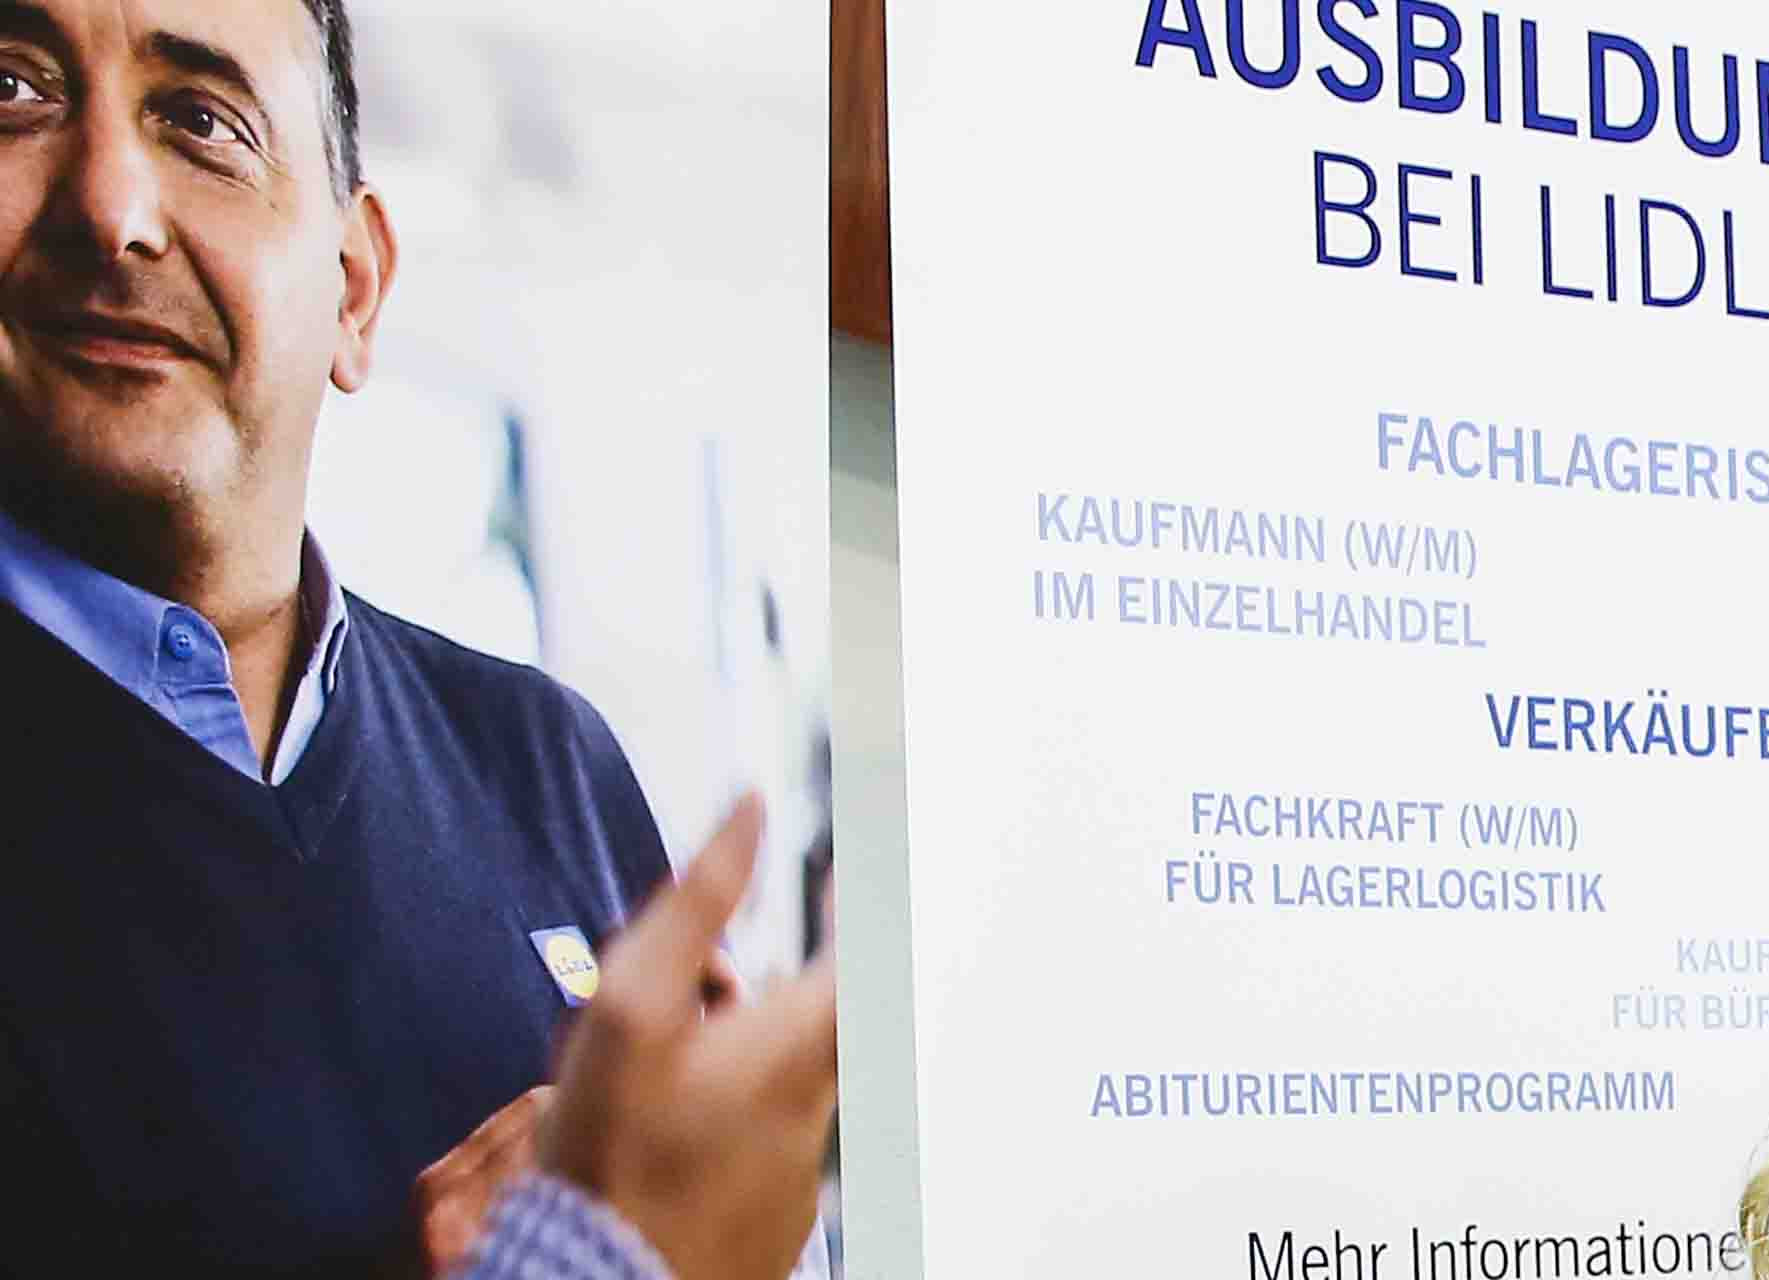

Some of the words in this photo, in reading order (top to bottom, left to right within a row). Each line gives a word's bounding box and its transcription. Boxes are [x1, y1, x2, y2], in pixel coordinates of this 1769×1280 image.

[1313, 150, 1485, 284] BEI
[1036, 490, 1327, 565] KAUFMANN
[1344, 518, 1479, 581] (W/M)
[1033, 569, 1095, 623] IM
[1118, 575, 1487, 650] EINZELHANDEL
[1190, 792, 1443, 845] FACHKRAFT
[1458, 800, 1580, 854] (W/M)
[1165, 852, 1257, 906] FÜR
[1271, 863, 1606, 914] LAGERLOGISTIK
[1611, 985, 1687, 1031] FÜR
[1089, 1069, 1677, 1118] ABITURIENTENPROGRAMM
